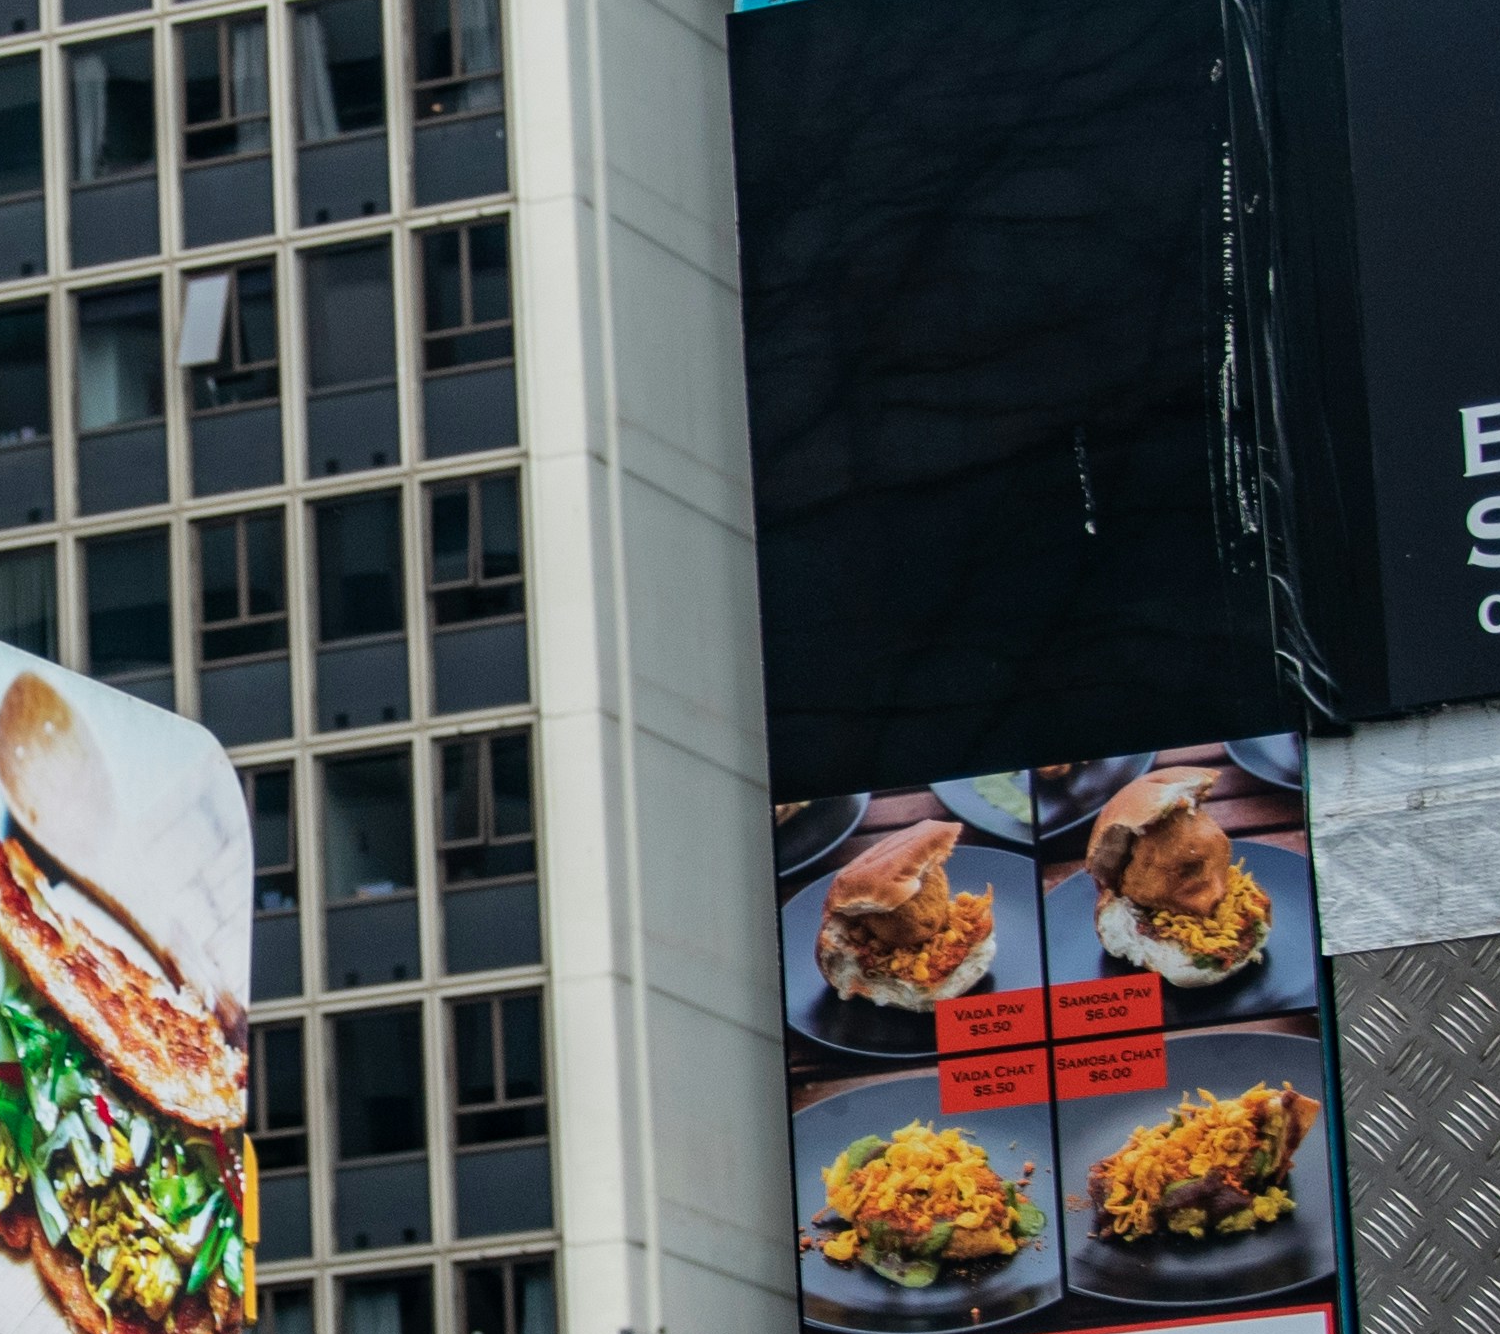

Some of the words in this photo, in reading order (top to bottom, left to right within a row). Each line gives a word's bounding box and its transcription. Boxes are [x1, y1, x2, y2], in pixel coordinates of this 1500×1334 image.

[1085, 1005, 1128, 1022] $6.00
[969, 1020, 1012, 1036] $5.50
[1089, 1067, 1132, 1083] $6.00
[973, 1081, 1016, 1097] $5.50
